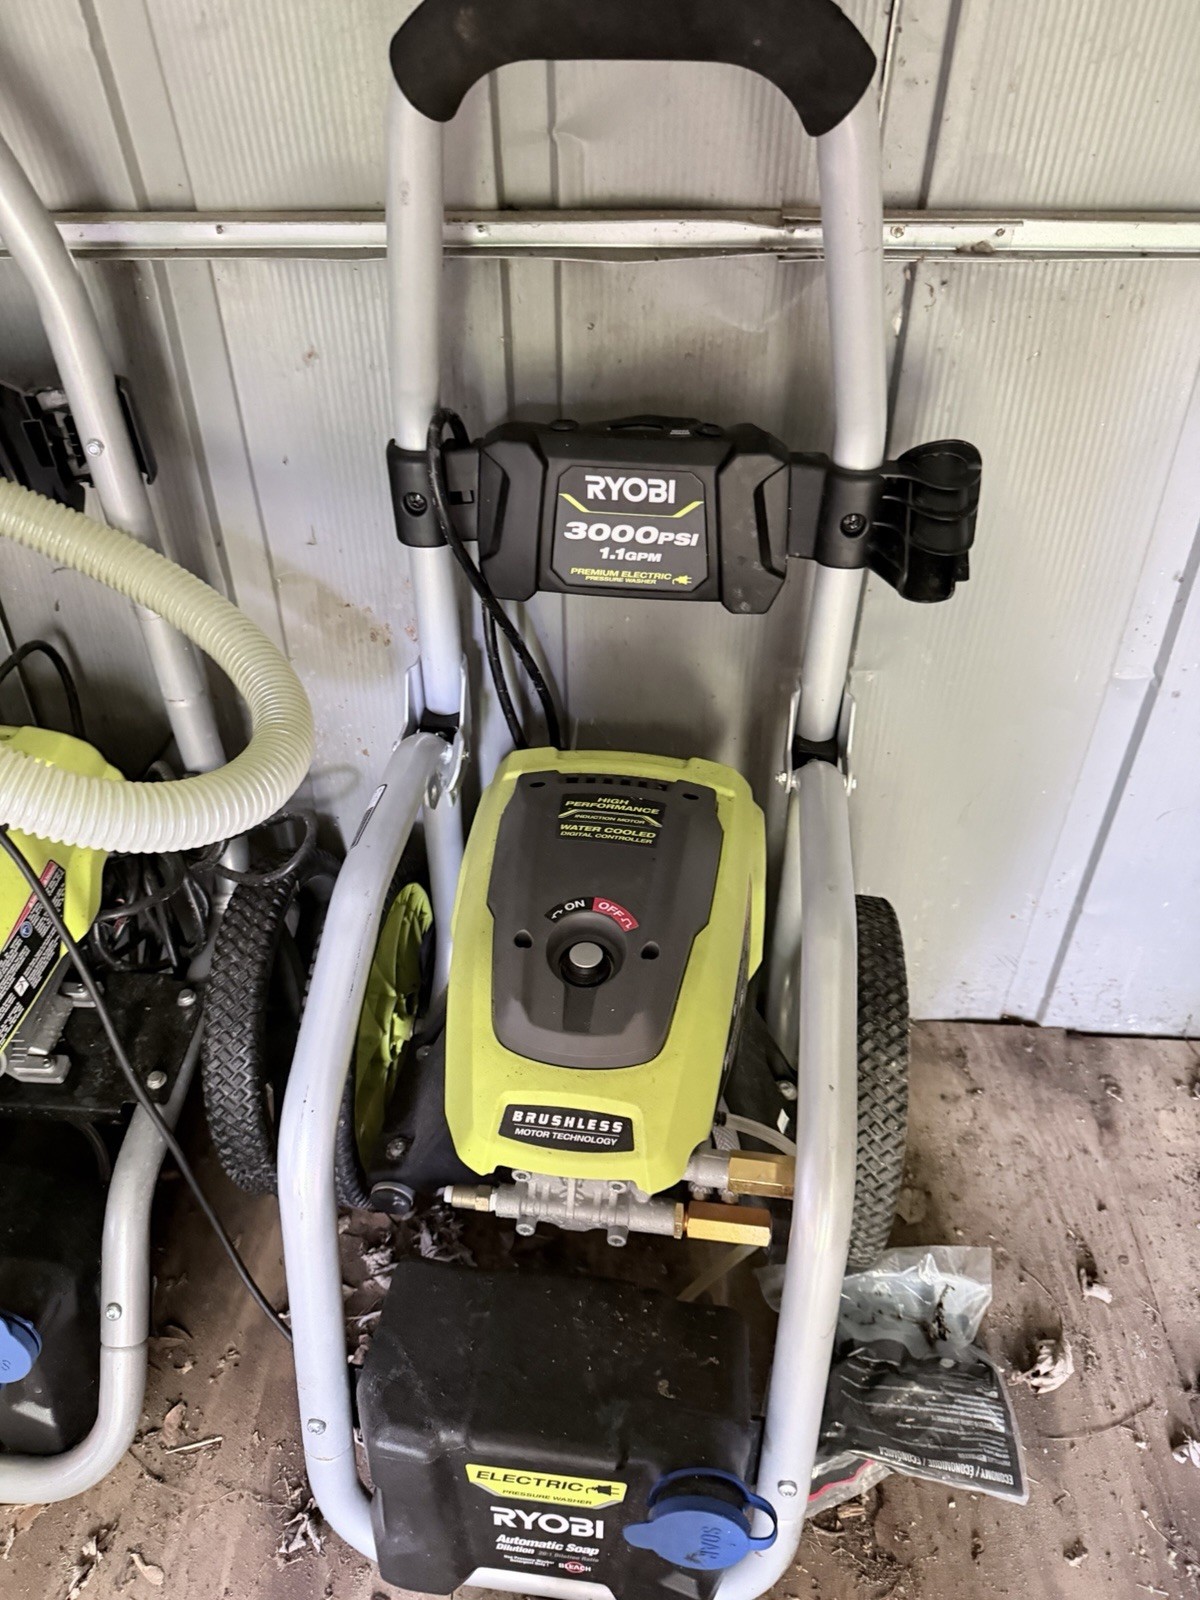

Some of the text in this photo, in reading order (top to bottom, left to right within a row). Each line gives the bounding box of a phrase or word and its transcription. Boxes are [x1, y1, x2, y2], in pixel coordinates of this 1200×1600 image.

[585, 475, 676, 504] RYOBI
[563, 521, 699, 547] 3000PSI
[599, 547, 662, 562] 1.1GPM
[570, 567, 672, 580] PREMIUM ELECTRIC
[585, 575, 657, 585] PRESSURE WASHER
[565, 800, 660, 815] PERFORMANCE
[597, 797, 629, 805] HIGH
[574, 814, 646, 825] INDUCTION MOTOR
[560, 824, 656, 838] WATER COOLED
[595, 833, 653, 844] CONTROLLER
[564, 899, 585, 911] ON
[598, 901, 625, 920] OFF
[512, 1110, 623, 1133] BRUSHLESS
[514, 1128, 618, 1146] MOTOR TECHNOLOGY
[476, 1470, 584, 1492] ELECTRIC
[502, 1489, 592, 1505] PRESSURE WASHER
[490, 1505, 604, 1539] RYOBI
[496, 1534, 599, 1556] Automatic Soap
[496, 1543, 535, 1554] Dilution
[558, 1562, 592, 1572] BLEACH
